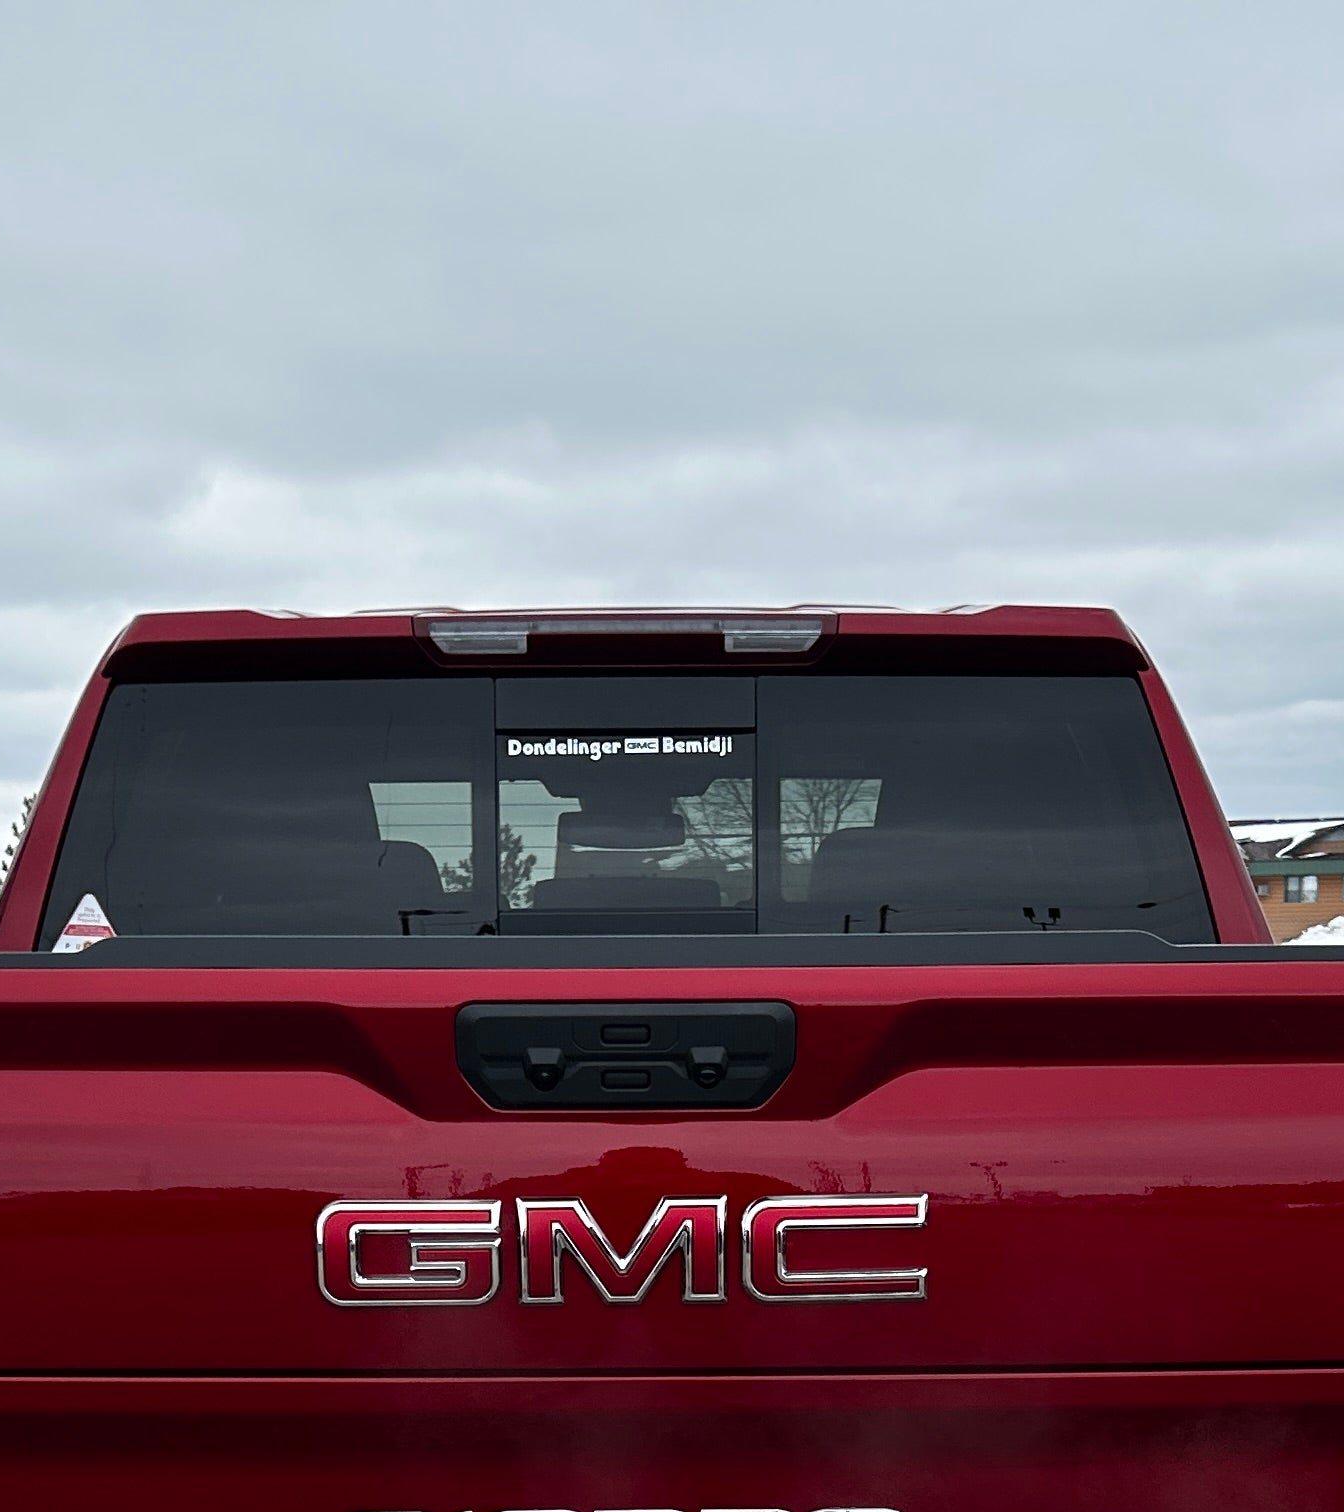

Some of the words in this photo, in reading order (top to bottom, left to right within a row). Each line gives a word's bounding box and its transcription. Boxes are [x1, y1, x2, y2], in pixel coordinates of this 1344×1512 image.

[507, 738, 622, 761] Dondelinger
[626, 741, 657, 750] GMC
[662, 736, 733, 757] Bemidji
[315, 1193, 929, 1306] GMC
